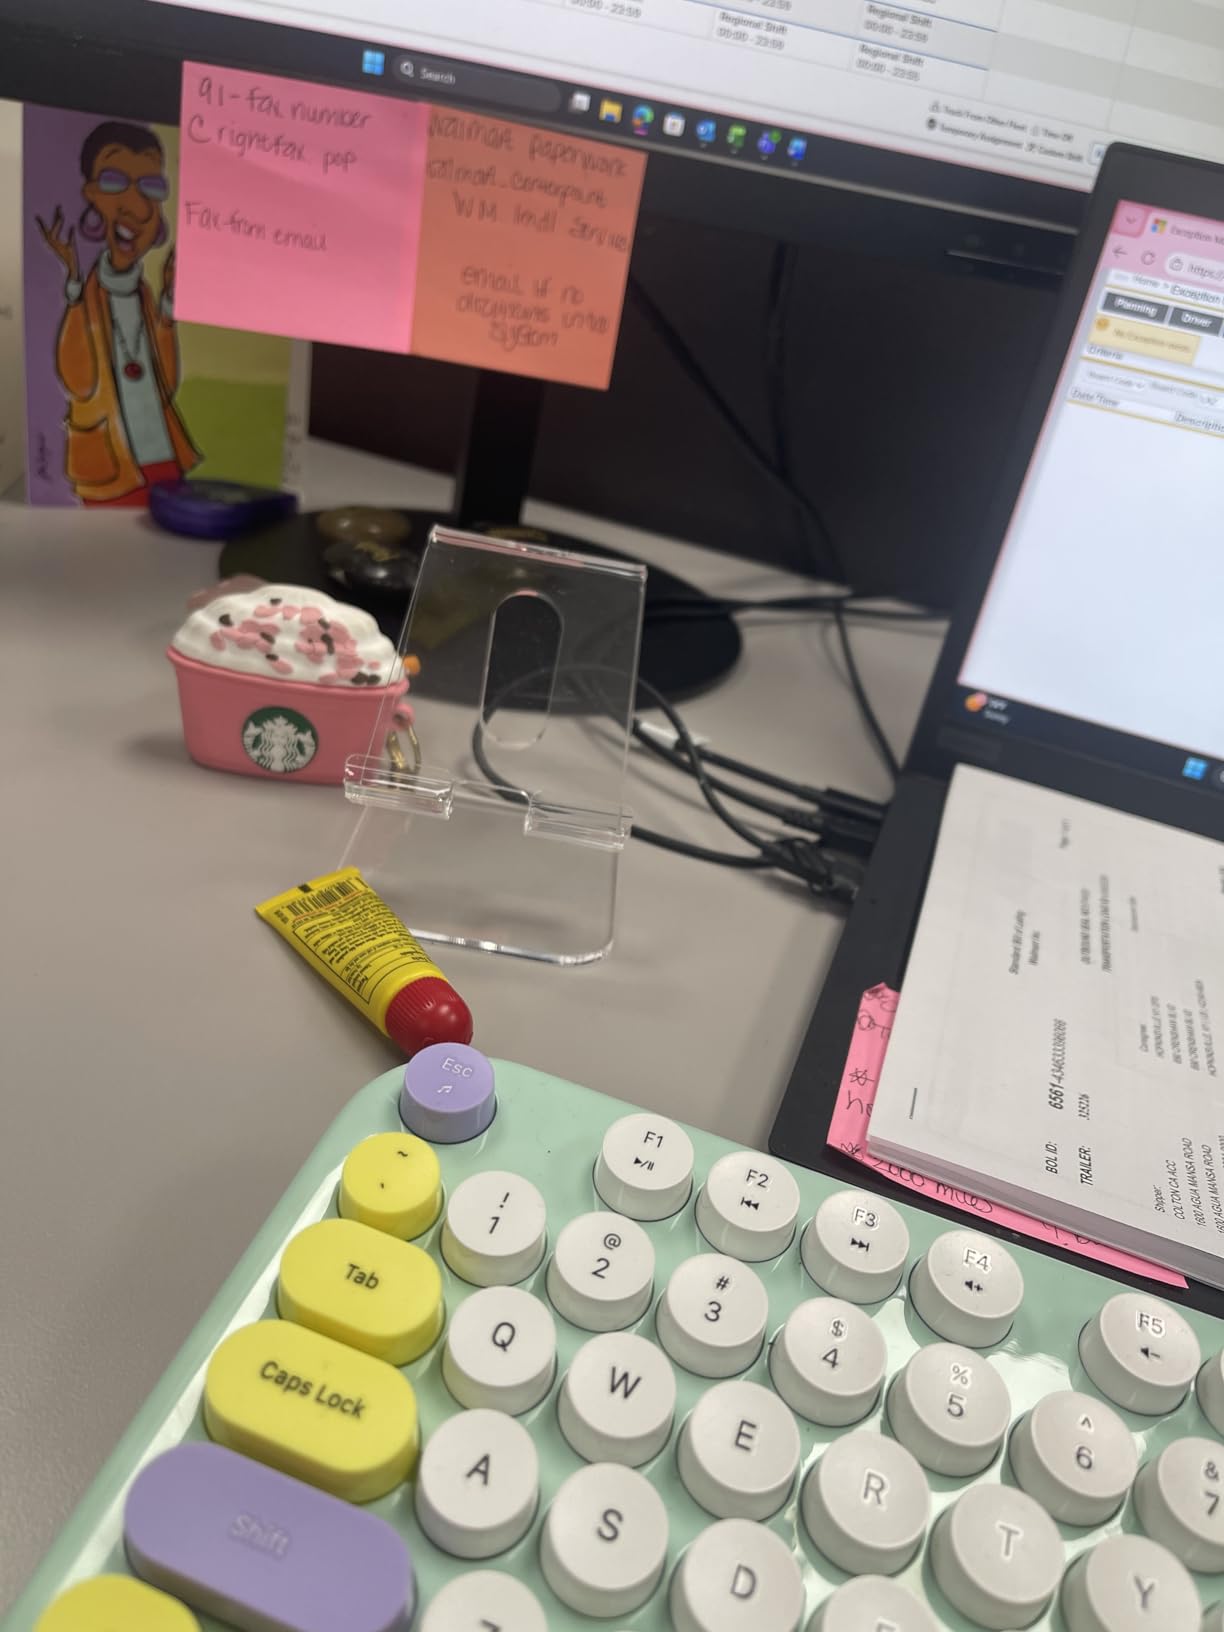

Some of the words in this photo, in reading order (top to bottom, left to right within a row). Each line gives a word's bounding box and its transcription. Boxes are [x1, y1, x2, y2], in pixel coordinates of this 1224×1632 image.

[420, 67, 456, 87] Search
[1114, 297, 1159, 318] Planning
[1181, 311, 1214, 328] Driver
[441, 1057, 474, 1079] Esc
[643, 1130, 664, 1149] F1
[1045, 1140, 1057, 1155] ID:
[1181, 1137, 1194, 1161] ROAD
[1045, 1155, 1058, 1175] BOL
[1078, 1145, 1093, 1187] TRAILER:
[1201, 1144, 1213, 1168] ROAD
[745, 1168, 769, 1189] F2
[1165, 1159, 1177, 1177] ACC
[1184, 1160, 1199, 1187] MANSA
[1169, 1177, 1181, 1190] CA
[1204, 1168, 1218, 1195] MANSA
[499, 1191, 511, 1209] !
[934, 1182, 994, 1214] miles
[1152, 1184, 1166, 1214] Shipper:
[1169, 1189, 1186, 1220] COLTON
[1187, 1188, 1203, 1211] AGUA
[1207, 1195, 1222, 1219] AGUA
[487, 1215, 501, 1235] 1
[853, 1208, 877, 1228] F3
[603, 1232, 622, 1251] @
[591, 1257, 611, 1280] 2
[963, 1249, 991, 1272] F4
[344, 1263, 380, 1291] Tab
[714, 1275, 730, 1291] #
[703, 1301, 722, 1323] 3
[1137, 1312, 1165, 1335] F5
[491, 1320, 517, 1353] Q
[831, 1319, 846, 1339] $
[821, 1347, 840, 1370] 4
[608, 1366, 643, 1400] W
[951, 1364, 969, 1386] %
[258, 1360, 315, 1400] Caps
[313, 1384, 368, 1421] Lock
[946, 1393, 966, 1419] 5
[734, 1419, 759, 1452] E
[464, 1452, 492, 1487] A
[1075, 1445, 1095, 1472] 6
[1203, 1461, 1221, 1482] &
[862, 1473, 888, 1506] R
[1204, 1491, 1221, 1517] 7
[229, 1512, 292, 1560] Shift
[595, 1508, 624, 1543] S
[998, 1525, 1021, 1558] T
[729, 1563, 758, 1601] D
[1133, 1574, 1156, 1610] Y
